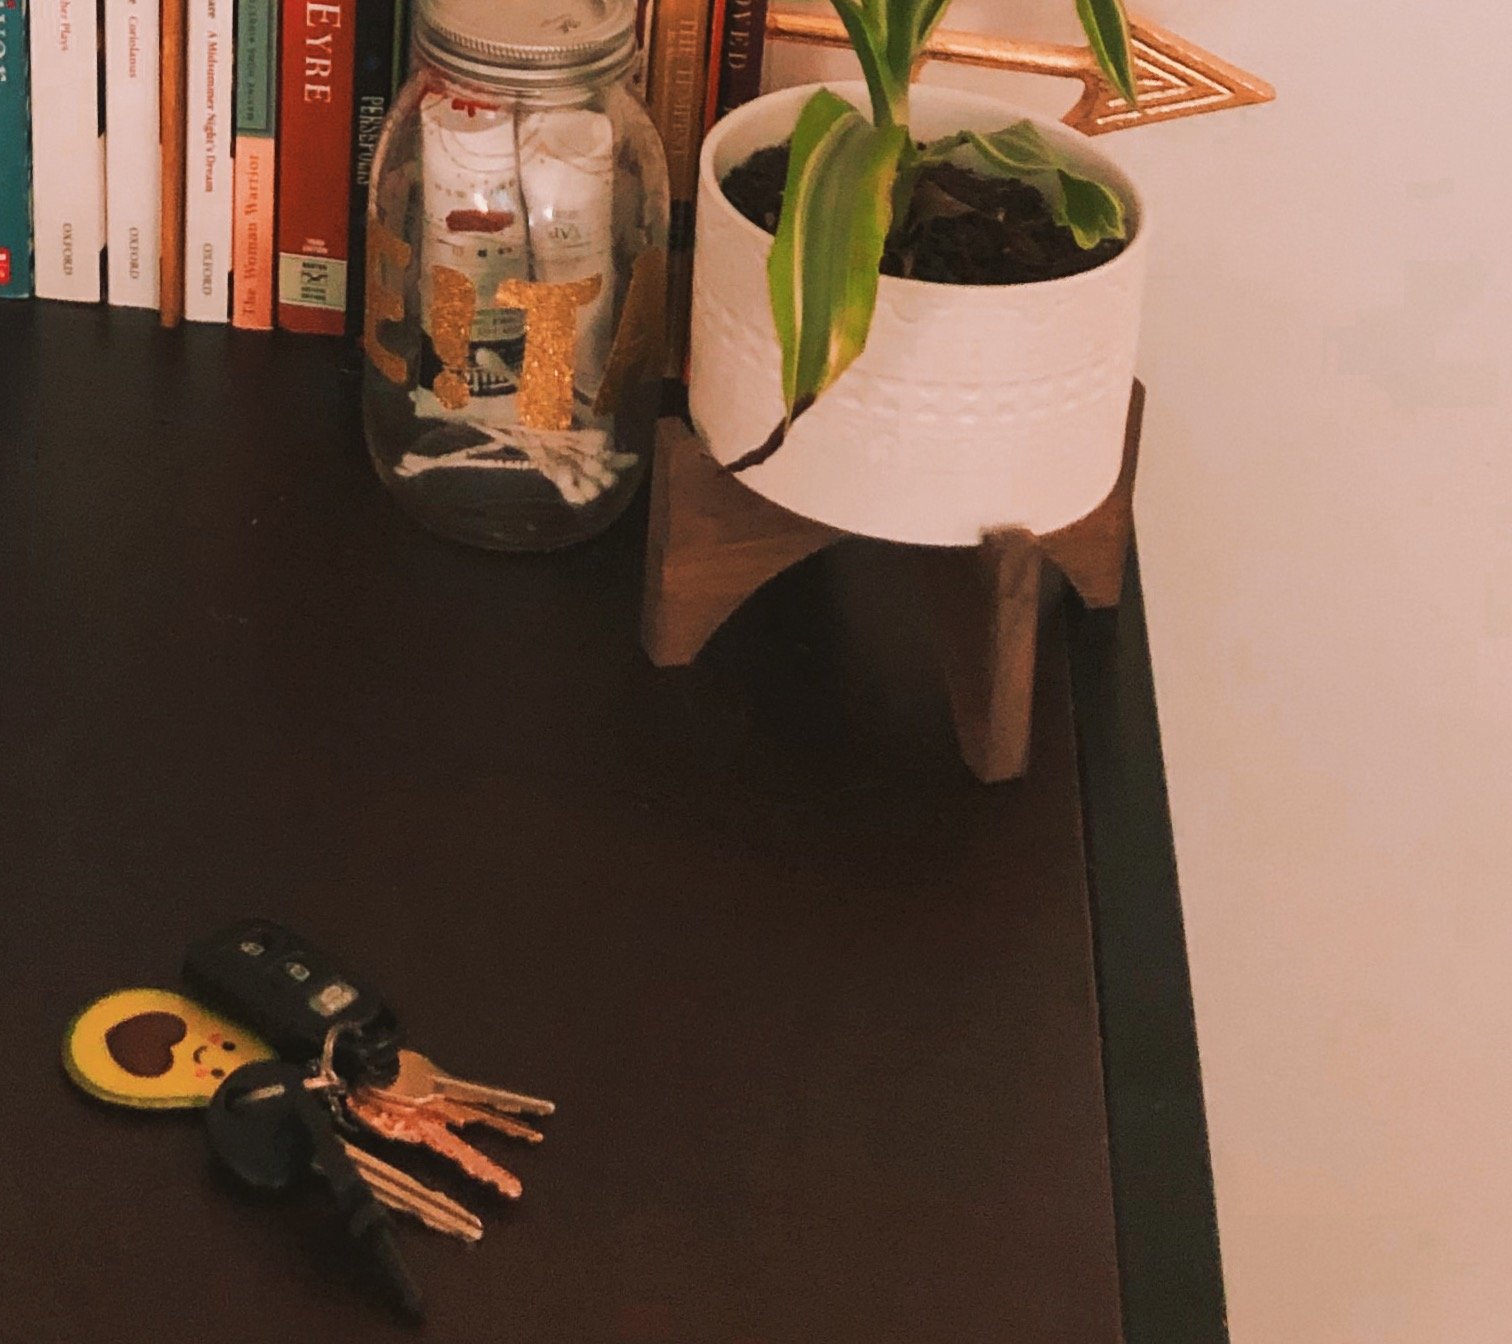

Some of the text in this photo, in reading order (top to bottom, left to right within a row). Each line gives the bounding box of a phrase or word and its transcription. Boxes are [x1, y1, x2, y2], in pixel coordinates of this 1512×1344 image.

[207, 30, 218, 39] A
[304, 0, 344, 104] EYRE
[206, 42, 218, 110] Midsummer
[204, 114, 218, 154] Night's
[205, 155, 217, 192] Dream
[242, 154, 259, 316] The Woman Warrior
[201, 242, 213, 297] OXFORD
